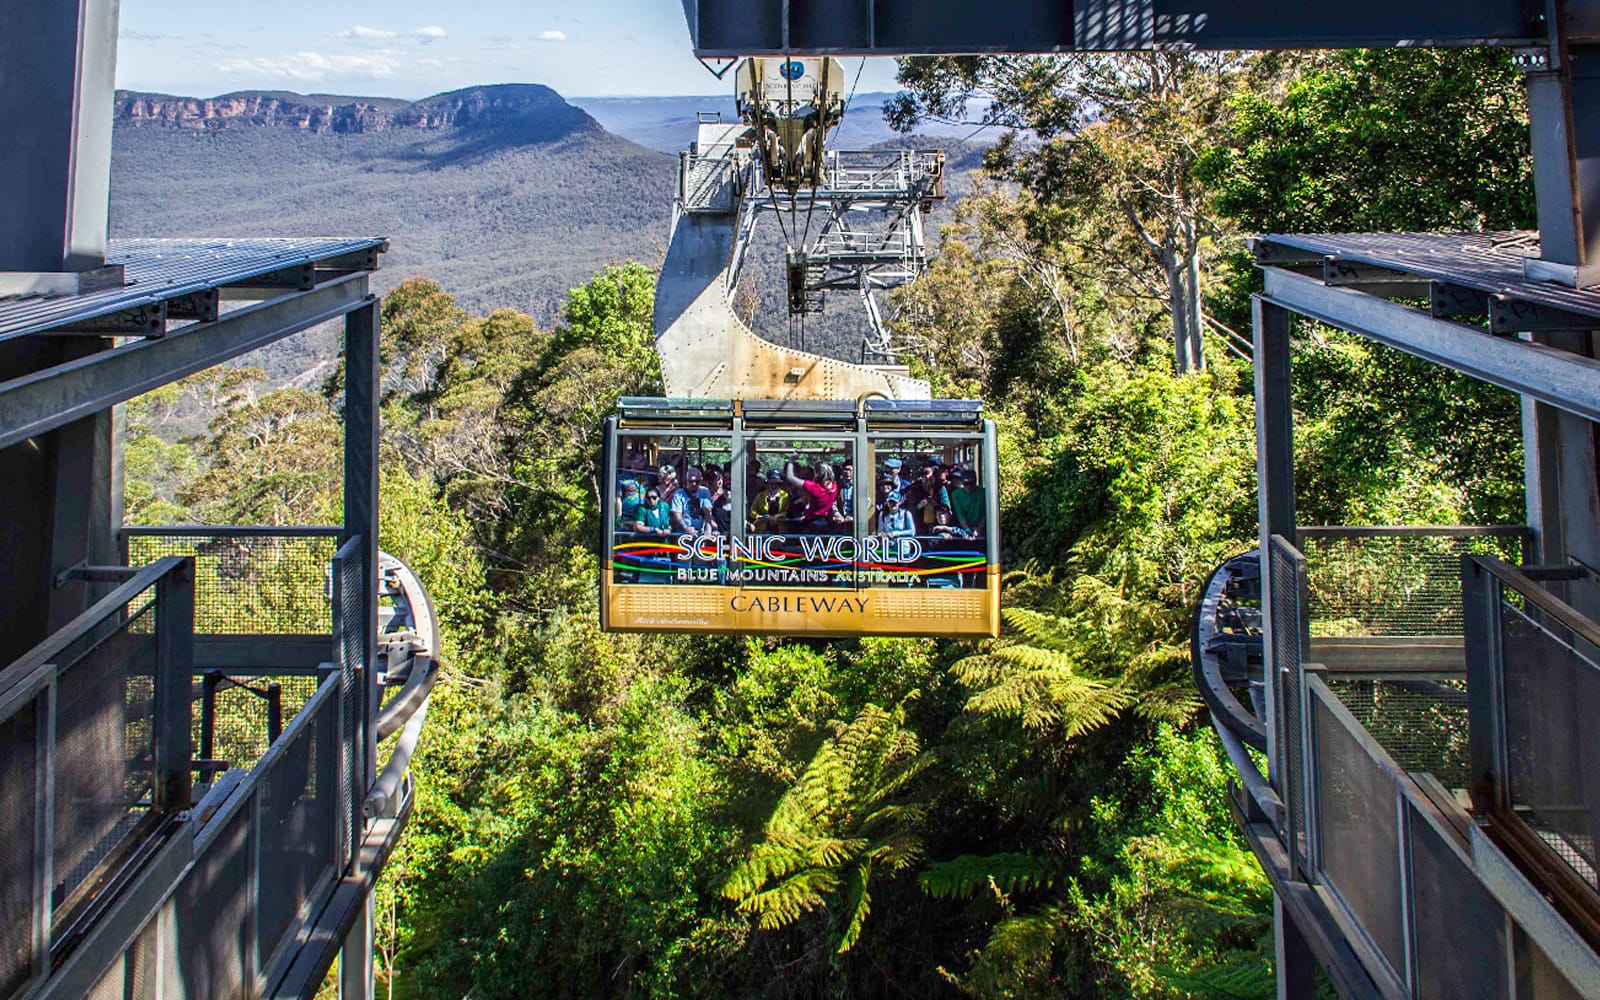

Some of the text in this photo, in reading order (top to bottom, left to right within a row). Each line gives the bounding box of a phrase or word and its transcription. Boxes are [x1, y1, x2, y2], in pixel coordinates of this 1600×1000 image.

[677, 534, 922, 563] SCENIC WORLD
[677, 567, 921, 583] BLUE MOUNTAINS AUSTRALIA
[730, 595, 869, 613] CABLEWAY
